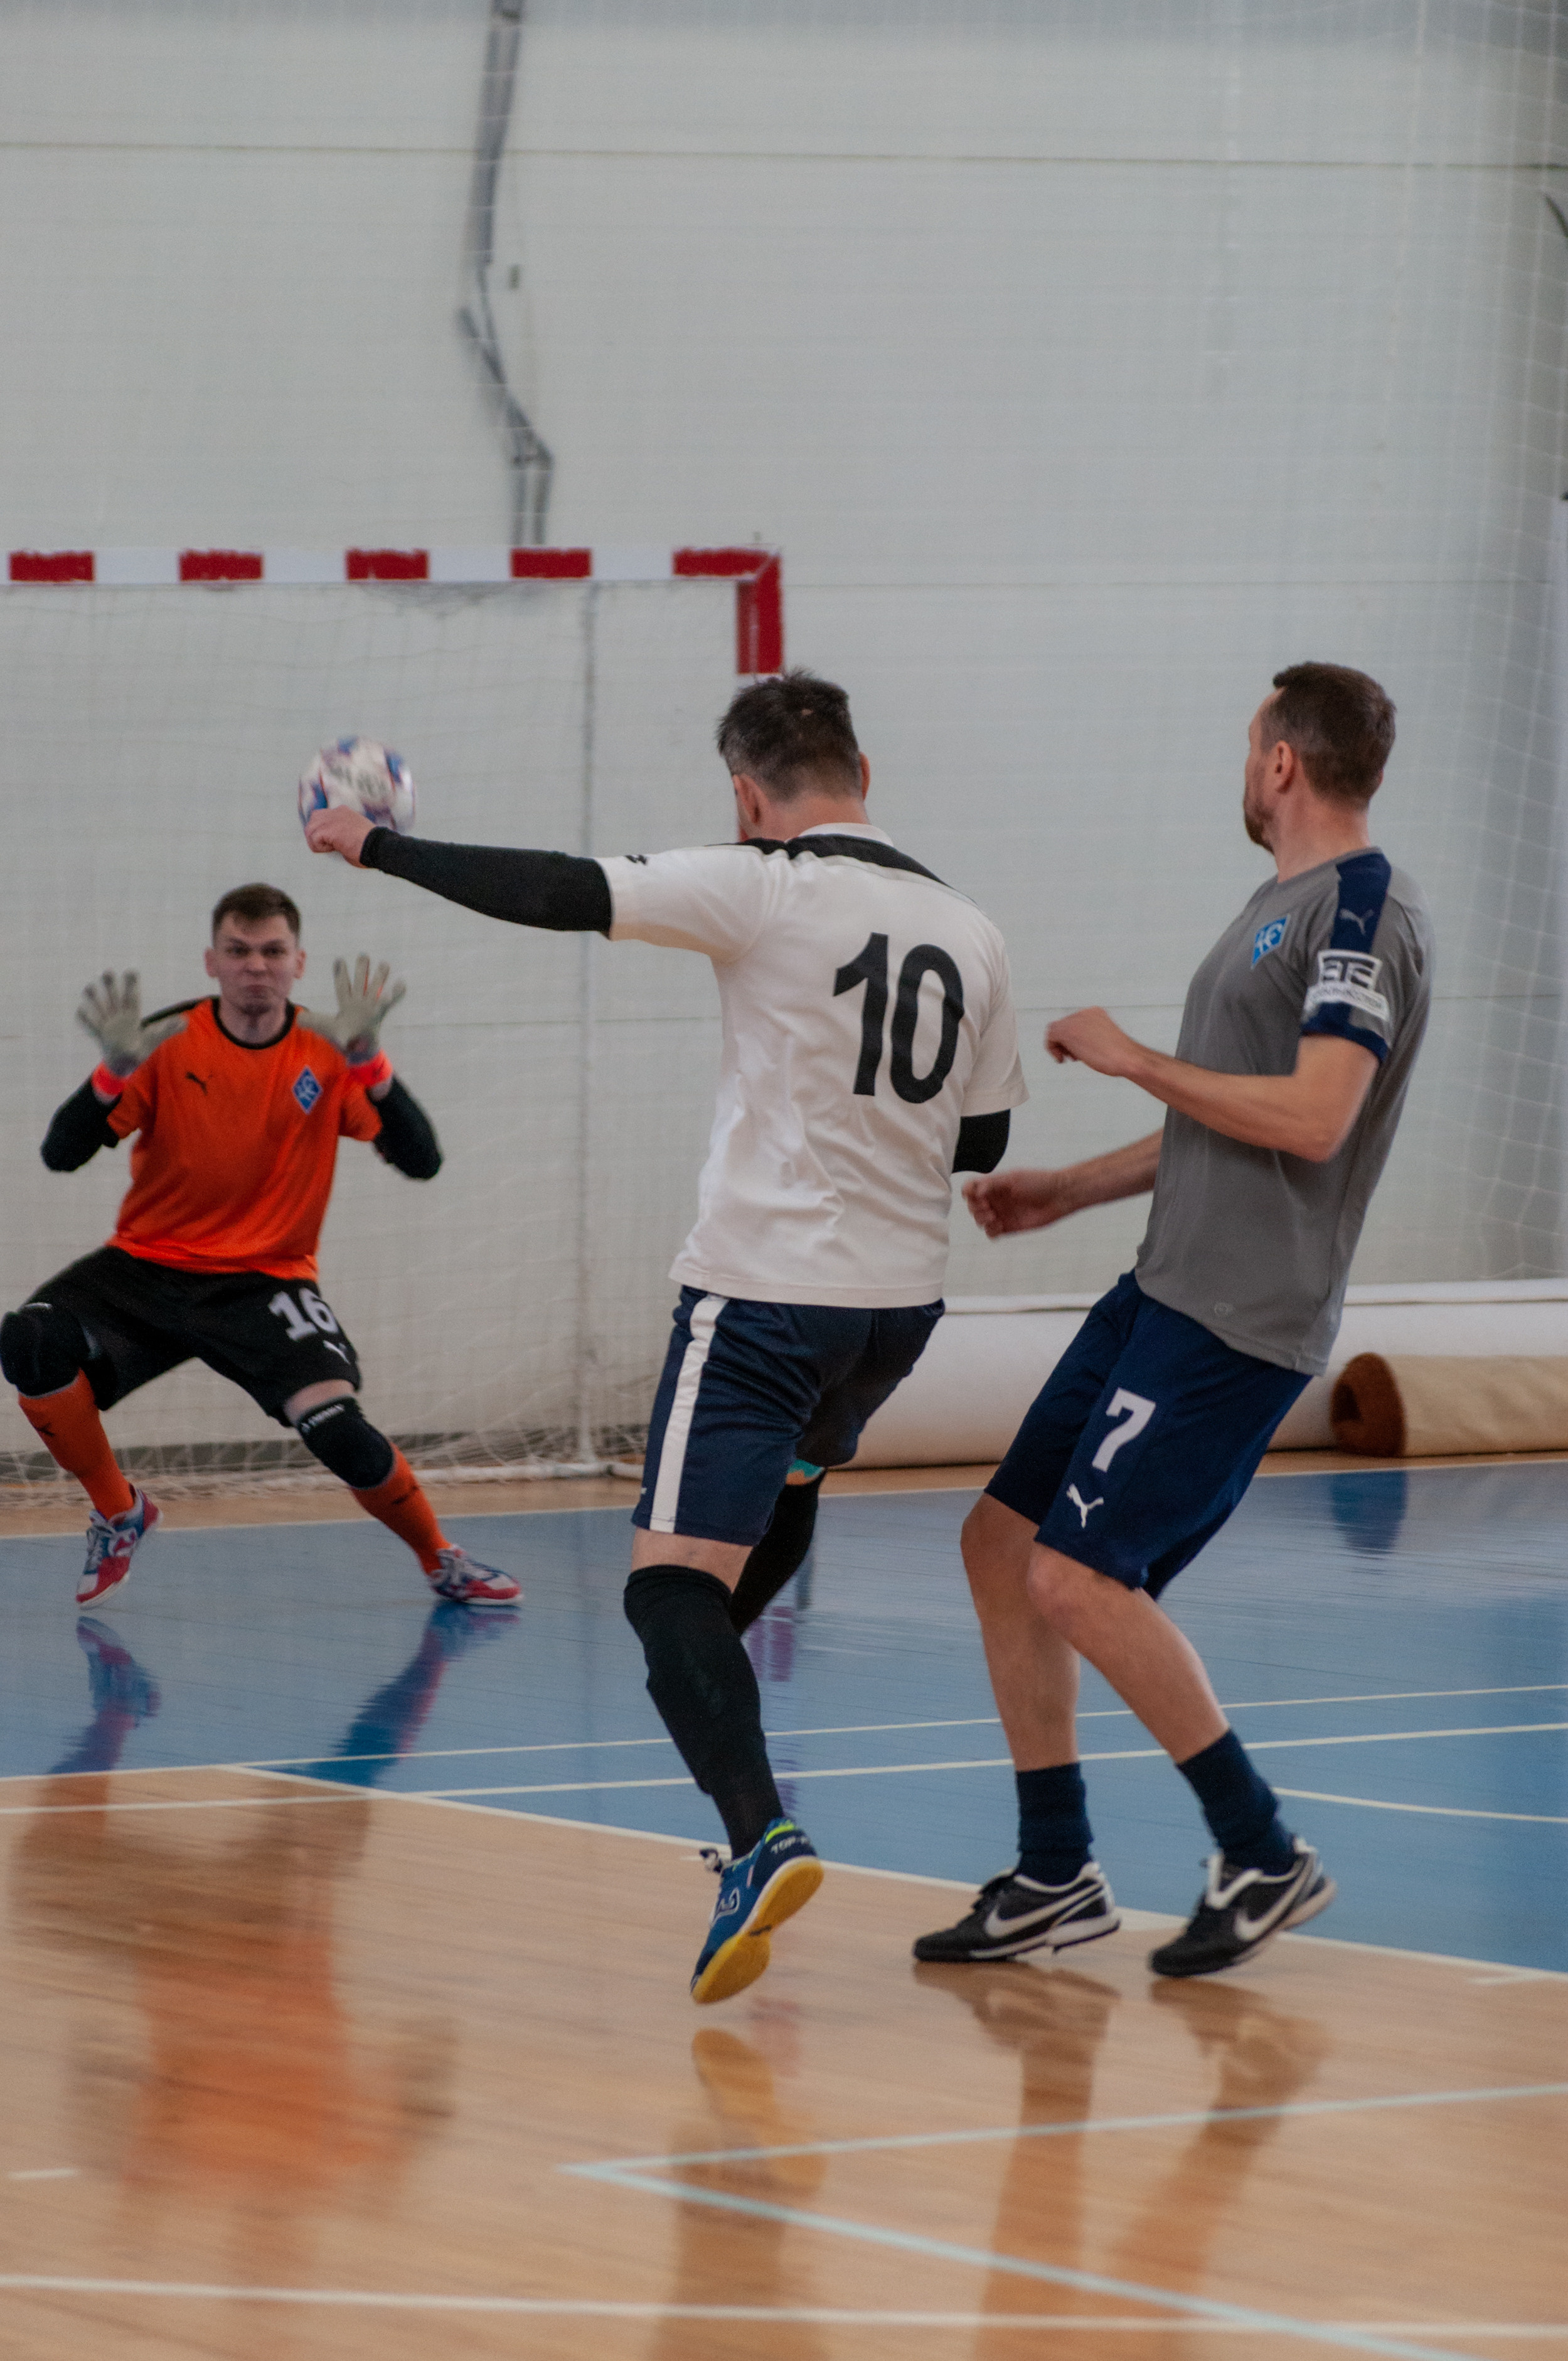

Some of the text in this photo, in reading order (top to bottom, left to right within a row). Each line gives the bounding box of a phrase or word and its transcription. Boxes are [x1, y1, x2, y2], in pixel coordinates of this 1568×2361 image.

[833, 932, 964, 1104] 10
[268, 1287, 341, 1341] 16
[1092, 1387, 1156, 1473] 7
